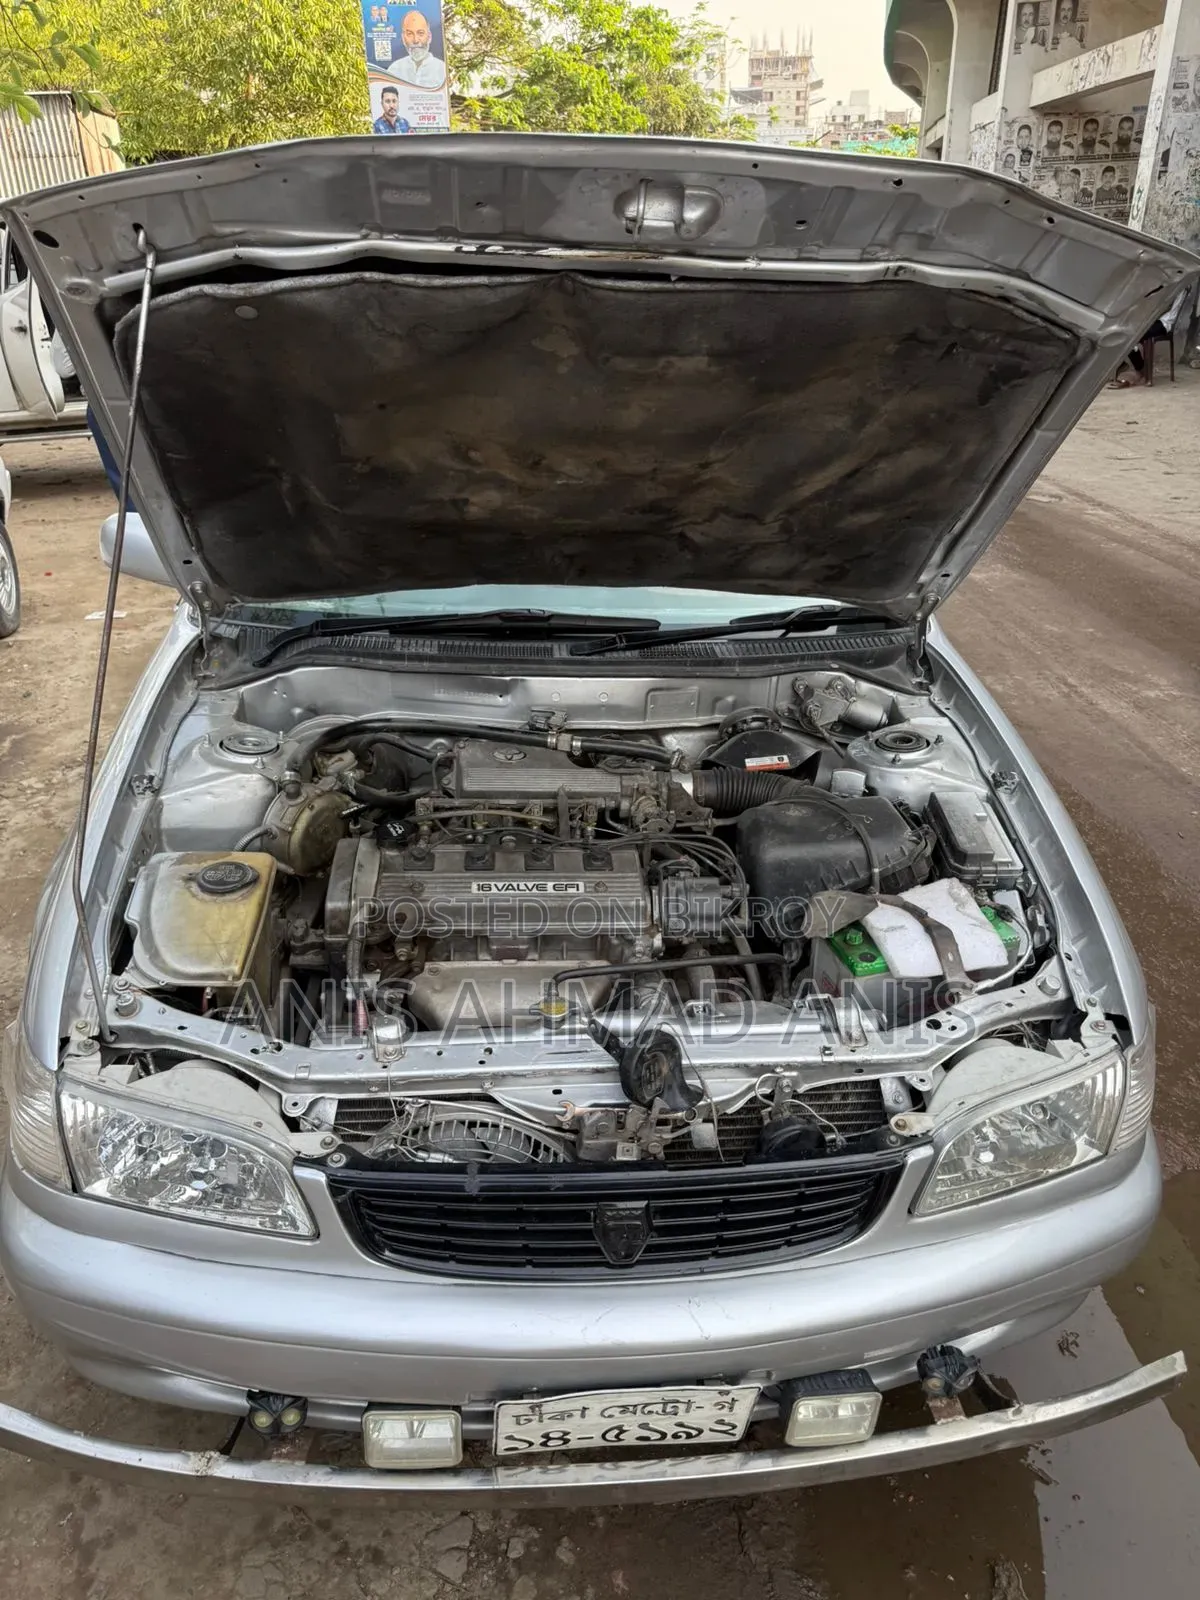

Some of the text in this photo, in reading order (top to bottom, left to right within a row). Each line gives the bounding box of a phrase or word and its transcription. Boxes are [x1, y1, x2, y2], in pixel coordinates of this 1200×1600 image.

[476, 883, 580, 892] 16 VALVE EFI
[512, 1405, 589, 1426] ঢাকা
[503, 1419, 739, 1451] ১৪-৫১৯২
